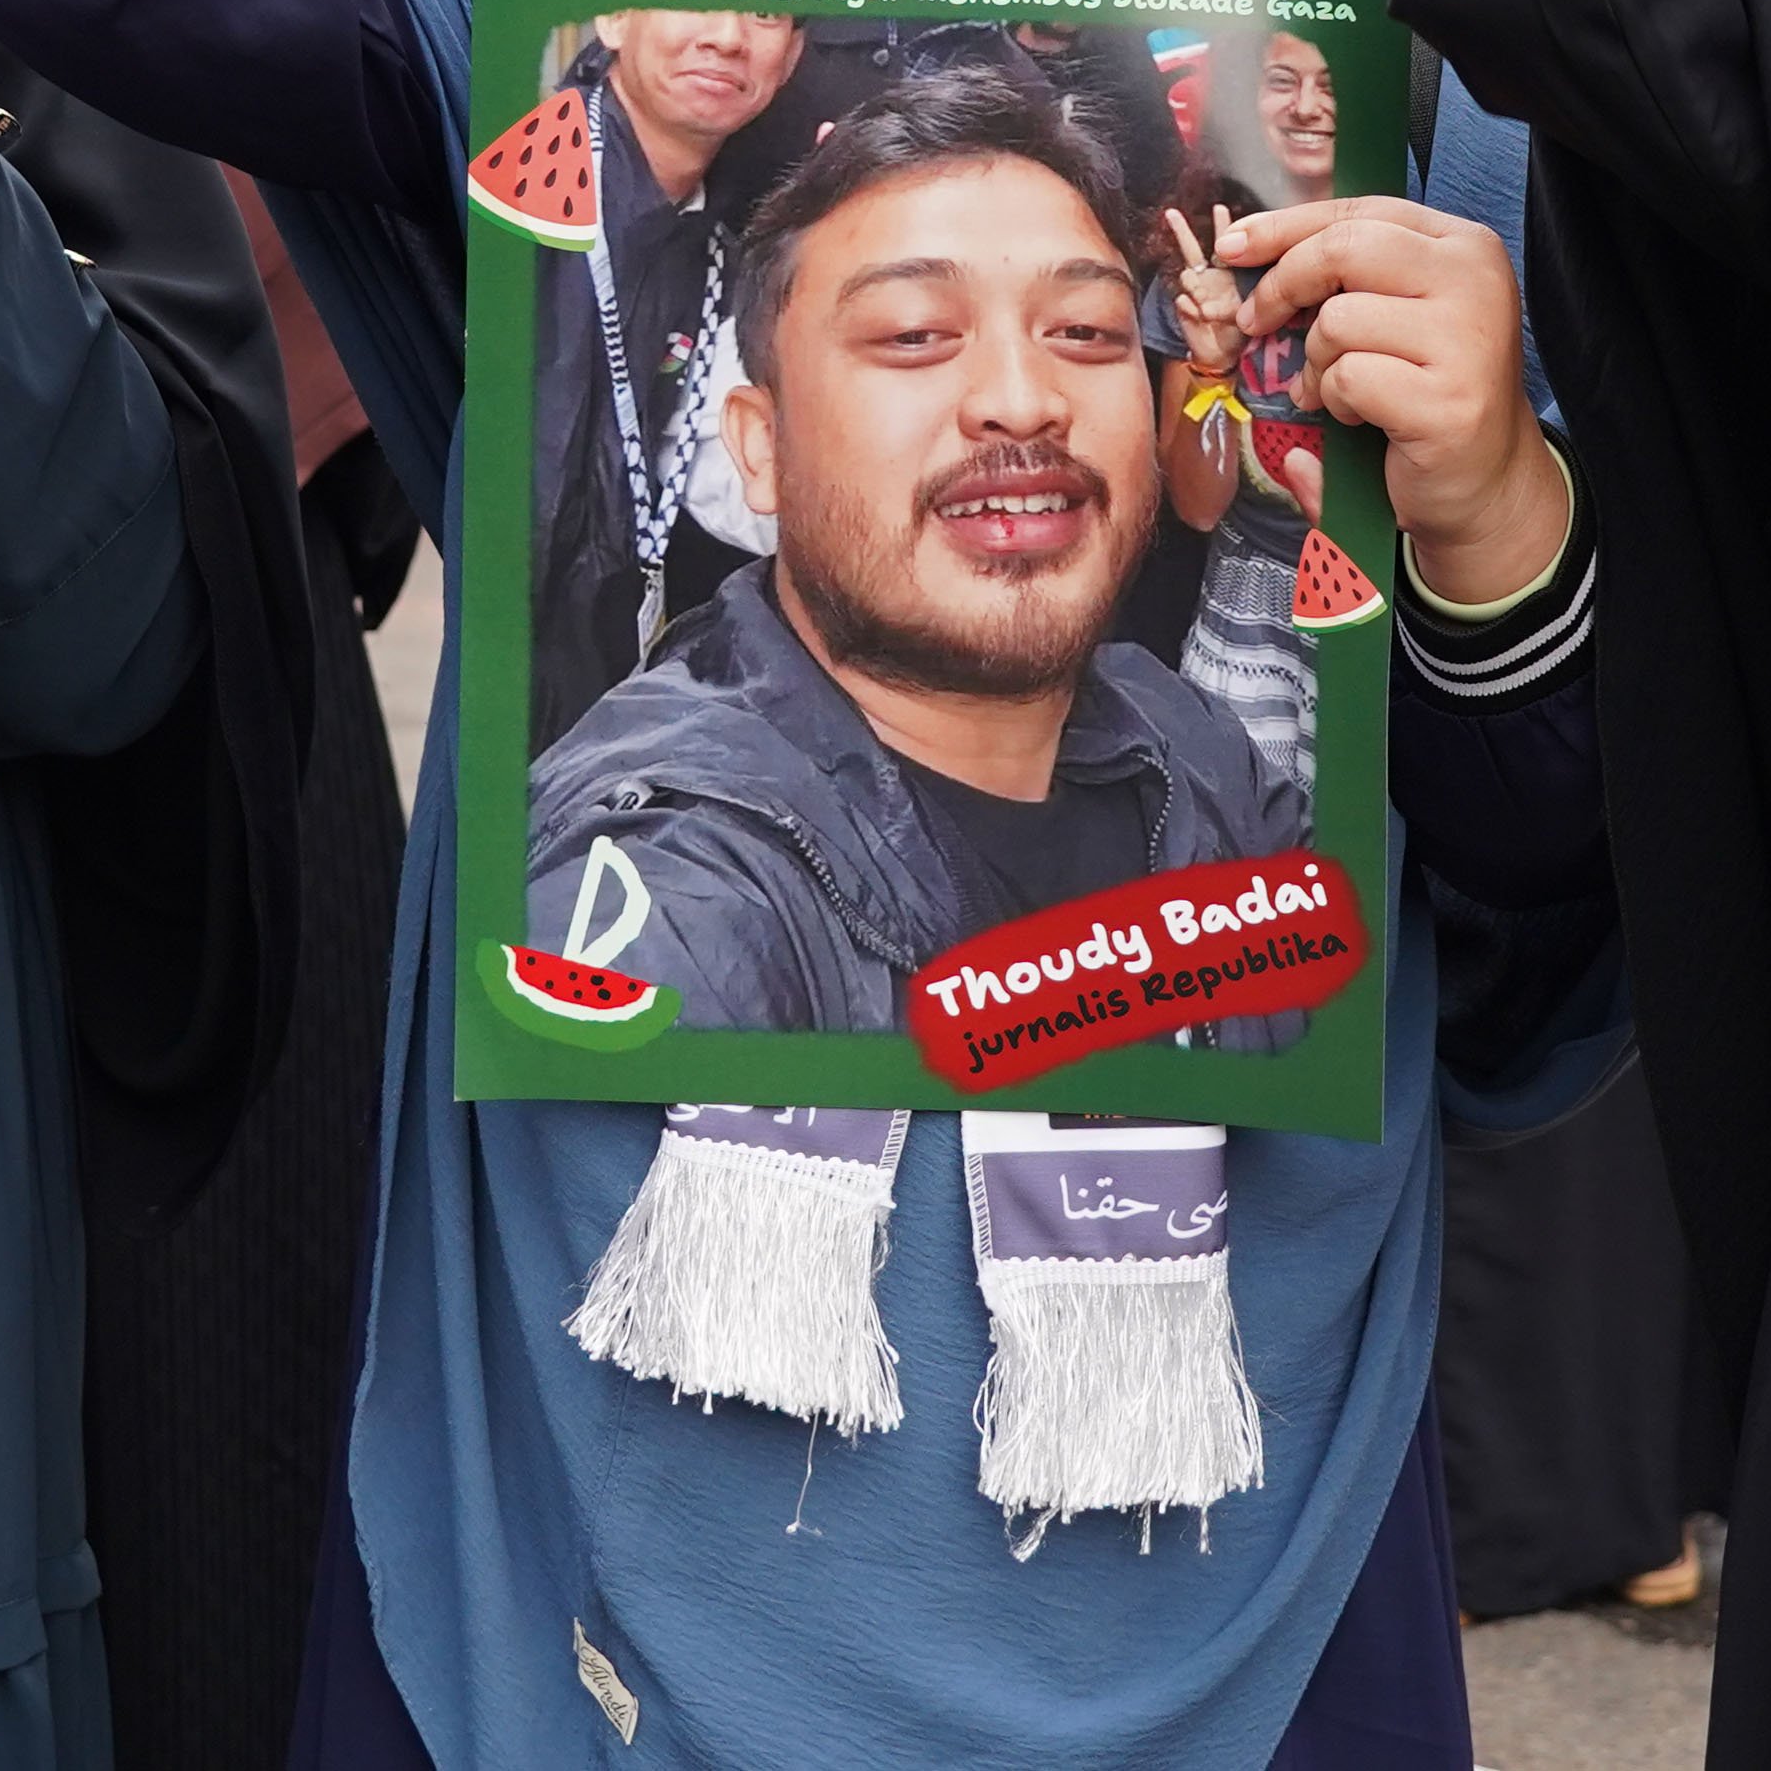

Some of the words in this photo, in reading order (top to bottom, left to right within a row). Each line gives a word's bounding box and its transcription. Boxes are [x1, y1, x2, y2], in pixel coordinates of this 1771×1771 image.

[926, 923, 1152, 1016] Thoudy
[1160, 863, 1328, 945] Badai
[963, 990, 1130, 1074] jurnalis
[1139, 932, 1348, 1006] Republika
[1059, 1173, 1160, 1220] حقنا
